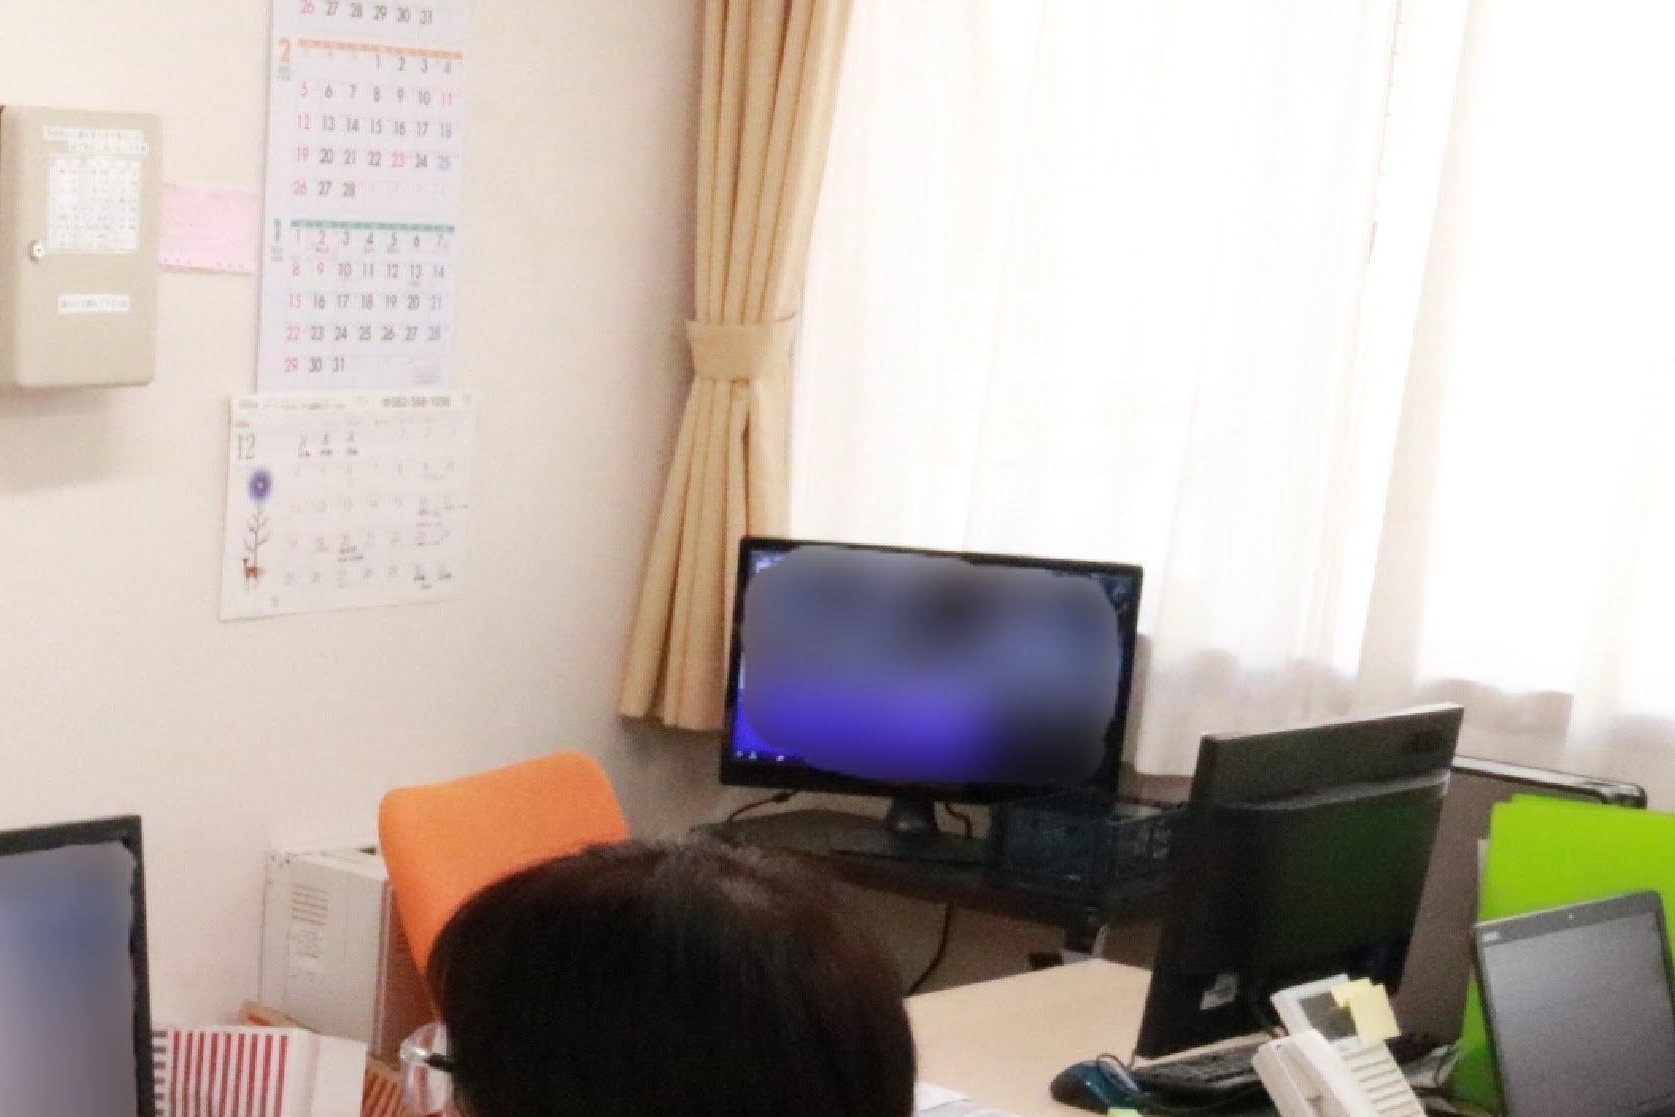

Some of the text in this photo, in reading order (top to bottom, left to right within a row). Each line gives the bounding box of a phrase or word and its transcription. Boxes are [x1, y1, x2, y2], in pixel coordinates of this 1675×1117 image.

[325, 1, 339, 16] 27
[350, 2, 363, 18] 28
[374, 5, 387, 20] 29
[278, 37, 292, 63] 2
[418, 90, 431, 105] 10
[441, 91, 454, 107] 11
[297, 114, 453, 138] 12 13 14 15 16 17 18
[296, 146, 451, 171] 19 20 21 22 23 24 25
[293, 180, 356, 197] 26 27 28
[274, 218, 282, 243] 1
[338, 262, 352, 278] 10
[362, 262, 375, 278] 11
[386, 263, 399, 279] 12
[409, 263, 423, 279] 13
[432, 264, 445, 279] 14
[288, 293, 442, 310] 15 16 17 18 19 20 21
[287, 325, 441, 341] 22 23 24 25 26 27 28
[285, 356, 345, 372] 29 30 31
[237, 433, 256, 460] 12
